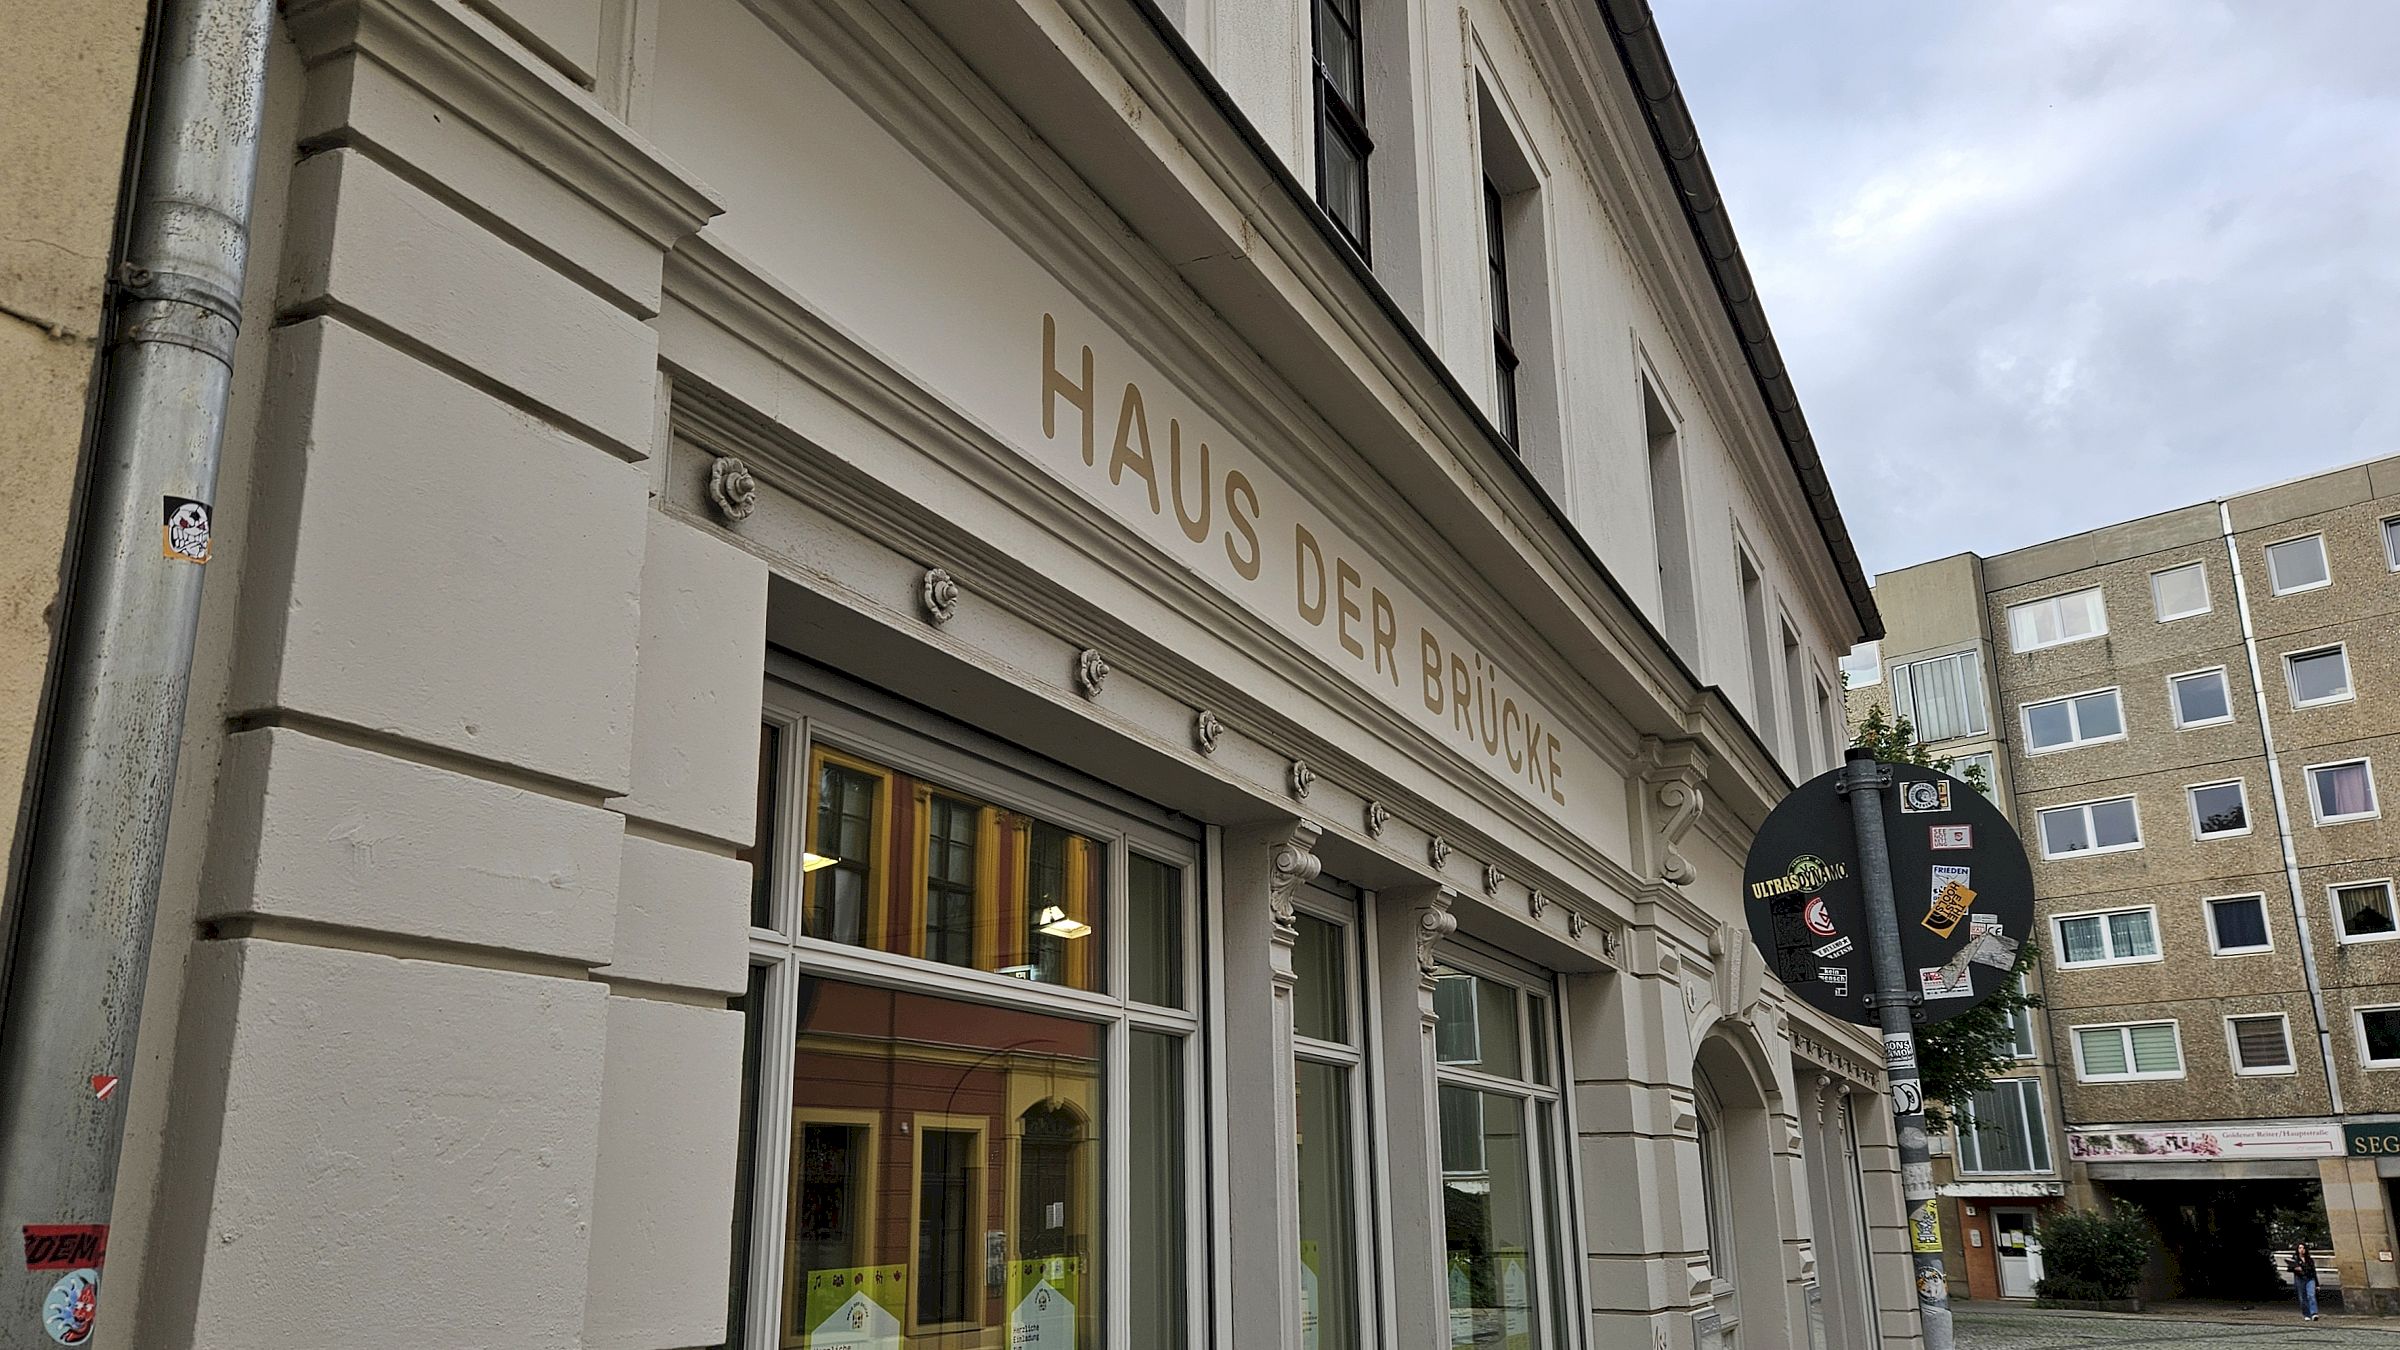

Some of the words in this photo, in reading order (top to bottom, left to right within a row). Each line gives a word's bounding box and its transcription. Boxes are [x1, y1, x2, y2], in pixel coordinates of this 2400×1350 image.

[1042, 312, 1261, 581] HAUS
[1295, 522, 1400, 687] DER
[1420, 626, 1566, 807] BRÜCKE
[1934, 867, 1969, 875] FRIEDEN
[1752, 874, 1800, 900] ULTRAS
[1936, 880, 1959, 912] HOOLS
[1943, 894, 1962, 918] EAST
[1950, 904, 1966, 921] THE
